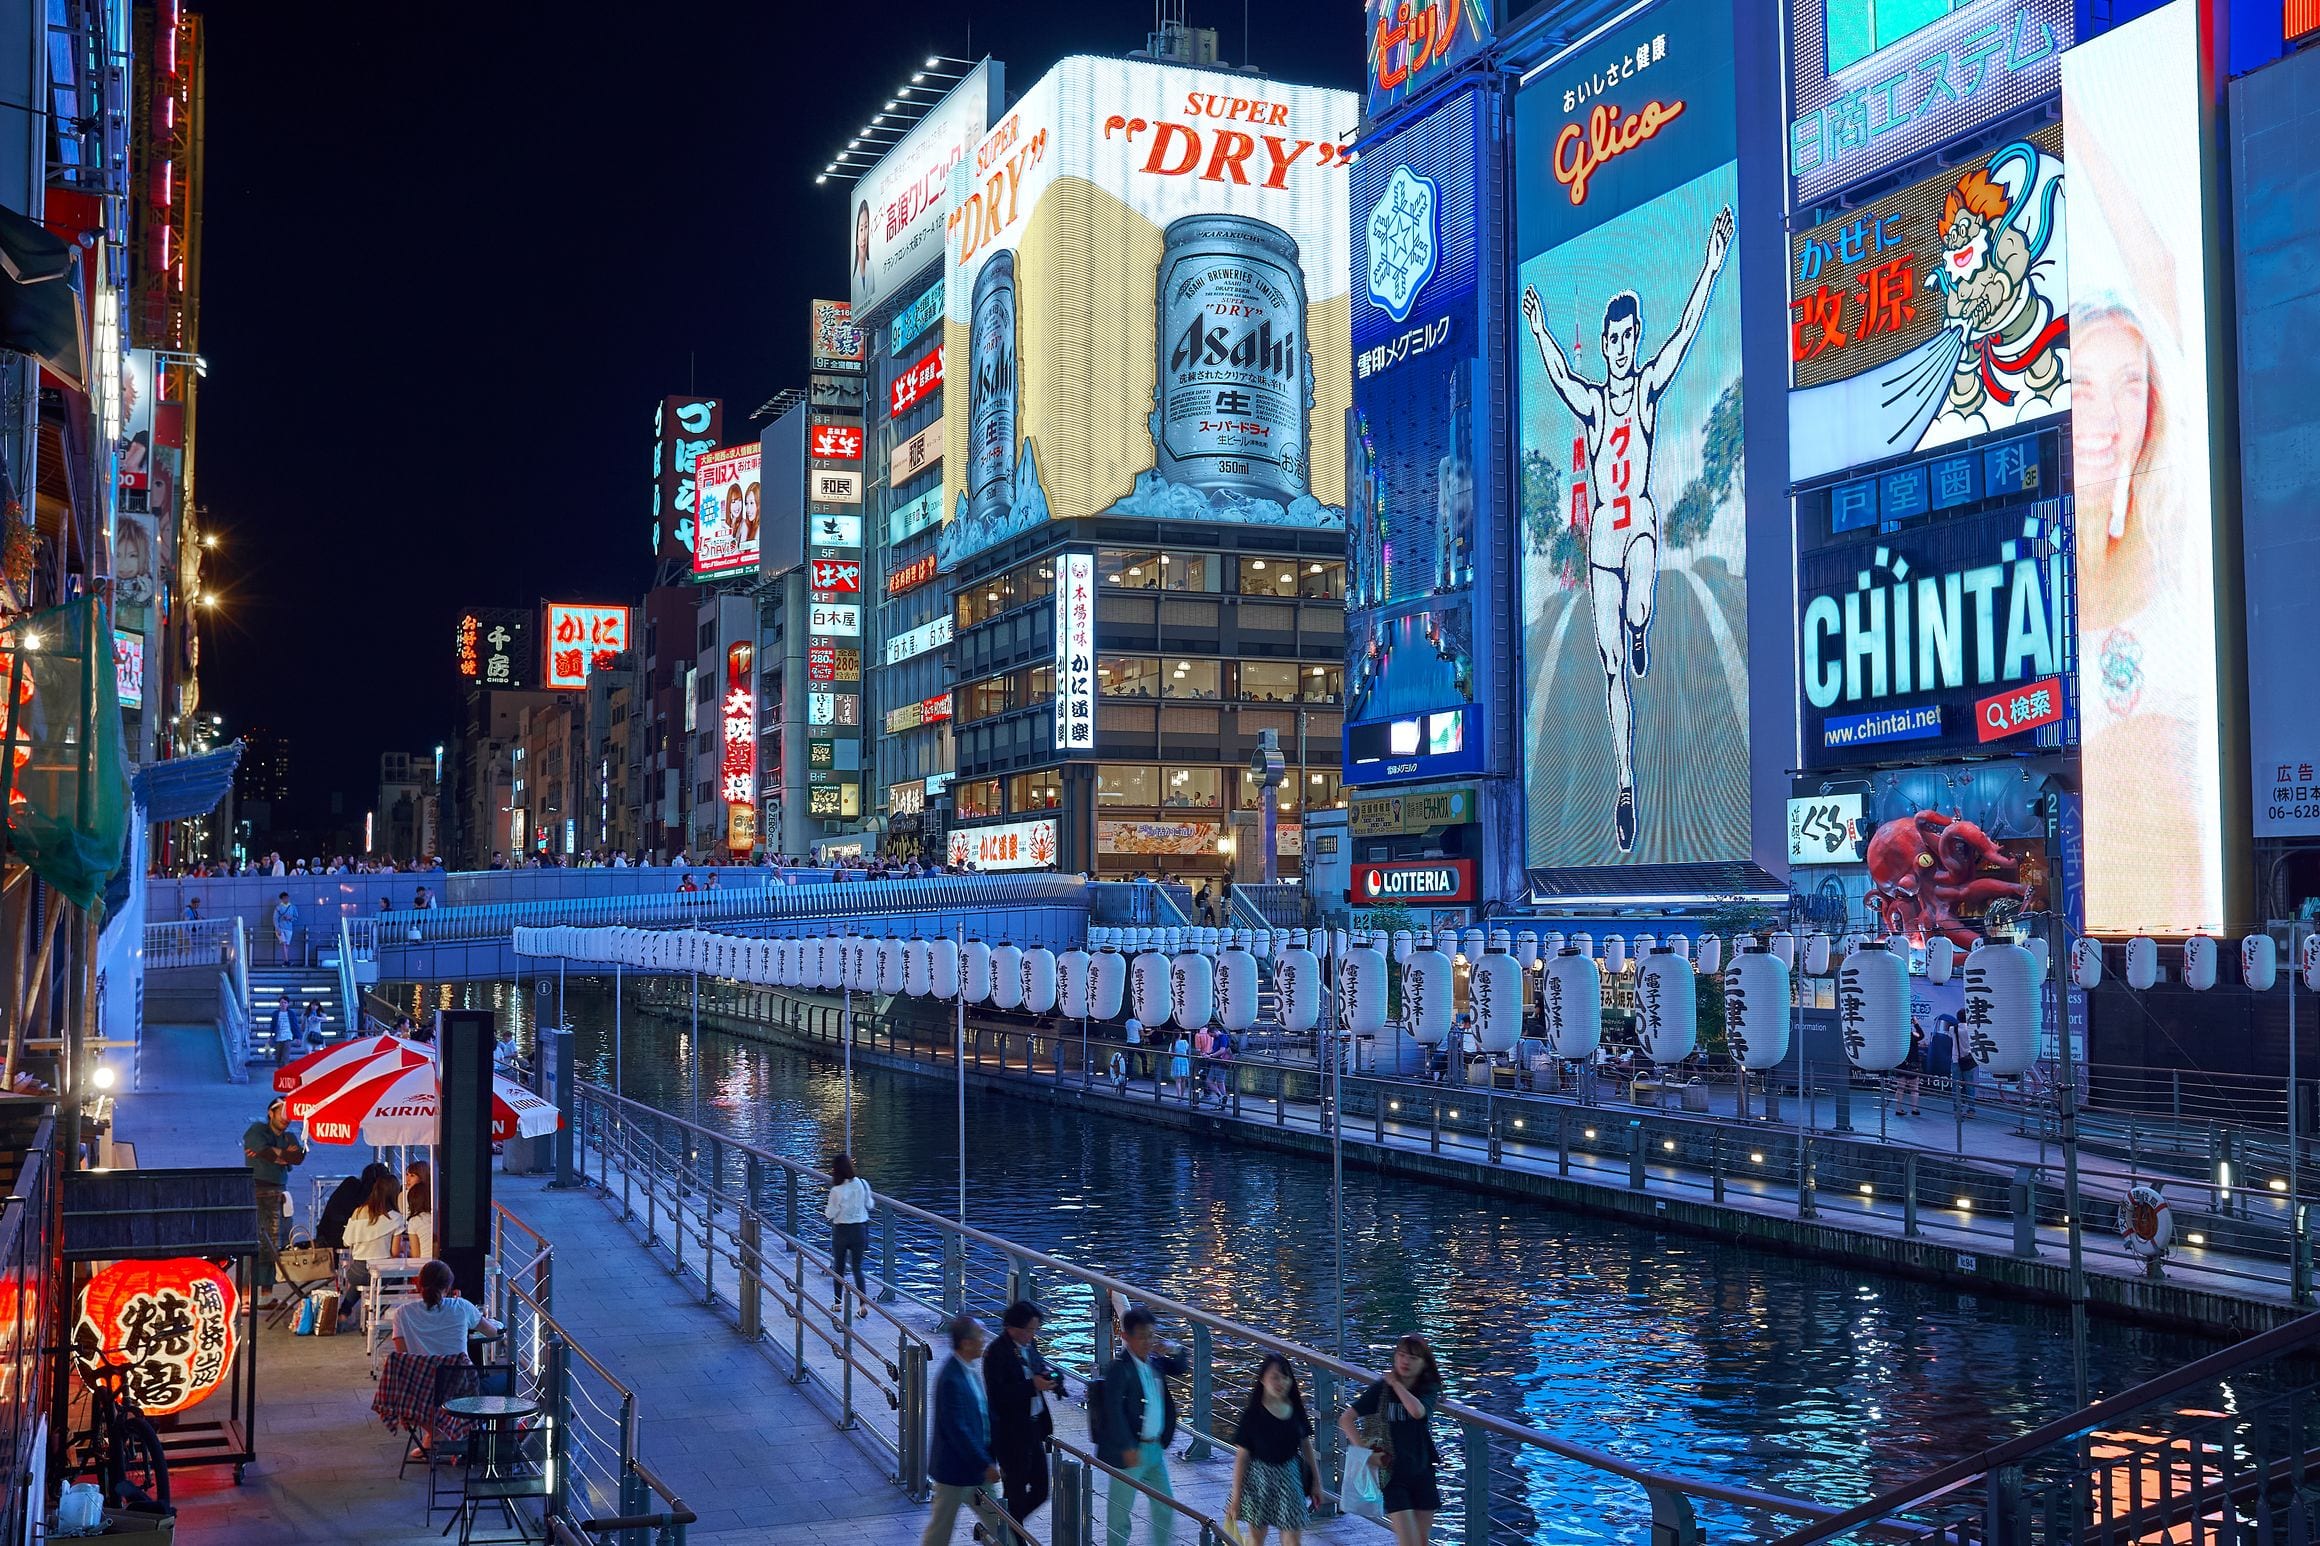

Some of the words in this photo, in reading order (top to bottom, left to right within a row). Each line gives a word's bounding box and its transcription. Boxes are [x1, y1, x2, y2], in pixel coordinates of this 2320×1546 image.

[1563, 34, 1667, 113] おいしさと健康
[1790, 9, 2056, 177] 日商エステム
[1184, 91, 1288, 127] SUPER
[976, 114, 1020, 178] SUPER
[1553, 99, 1686, 206] Glico
[1799, 211, 1905, 282] かぜに
[1185, 277, 1206, 299] ASAHI
[1207, 269, 1253, 284] BREWERIES
[1255, 280, 1281, 309] LIMITED
[1789, 252, 1915, 364] 改源
[816, 357, 829, 368] 9F
[1171, 312, 1293, 381] Asahi
[1357, 315, 1450, 380] 雪印メグミルク
[1215, 390, 1252, 416] 生
[985, 419, 998, 447] 生
[1198, 420, 1270, 438] スーパードライ
[703, 464, 740, 488] 高収入
[823, 479, 850, 494] 和民
[1218, 461, 1250, 475] 350ml
[1281, 452, 1304, 481] お酒
[1608, 417, 1633, 532] グリコ
[2025, 469, 2037, 487] 3F
[821, 549, 835, 558] 5F
[812, 563, 859, 589] はや
[556, 613, 620, 646] かに
[813, 609, 856, 627] 白木屋
[1072, 584, 1088, 647] 本場の味
[1803, 516, 2072, 709] CHINTAI
[487, 625, 511, 677] 千房
[1071, 653, 1089, 742] かに道楽
[2009, 690, 2053, 727] 検索
[2276, 763, 2314, 783] 広告
[2268, 804, 2320, 820] 06-628
[2272, 785, 2320, 803] (株)日本
[768, 813, 777, 835] ZERO
[1801, 804, 1848, 853] くくる
[2047, 793, 2058, 838] 2F
[980, 832, 1018, 863] かに道楽
[1383, 870, 1451, 893] LOTTERIA
[1134, 968, 1145, 1012] 電子マネー
[1175, 968, 1186, 1015] 電子マネー
[1218, 965, 1230, 1014] 電子マネー
[1283, 965, 1297, 1014] 電子マネー
[1346, 963, 1360, 1018] 電子マネー
[1411, 969, 1426, 1027] 電子マネー
[1477, 969, 1493, 1030] 電子マネー
[1548, 976, 1564, 1039] 電子マネー
[1644, 972, 1662, 1039] 電子マネー
[2046, 992, 2082, 1005] Exess
[1793, 1021, 1827, 1032] inormation
[1840, 967, 1866, 1060] 三津寺
[1965, 967, 1999, 1064] 三津寺
[2046, 1013, 2082, 1026] Aiort
[375, 1106, 439, 1118] KIRIN
[508, 1096, 547, 1111] KIRIN
[316, 1122, 351, 1139] KIRIN
[192, 1281, 225, 1389] 備長炭
